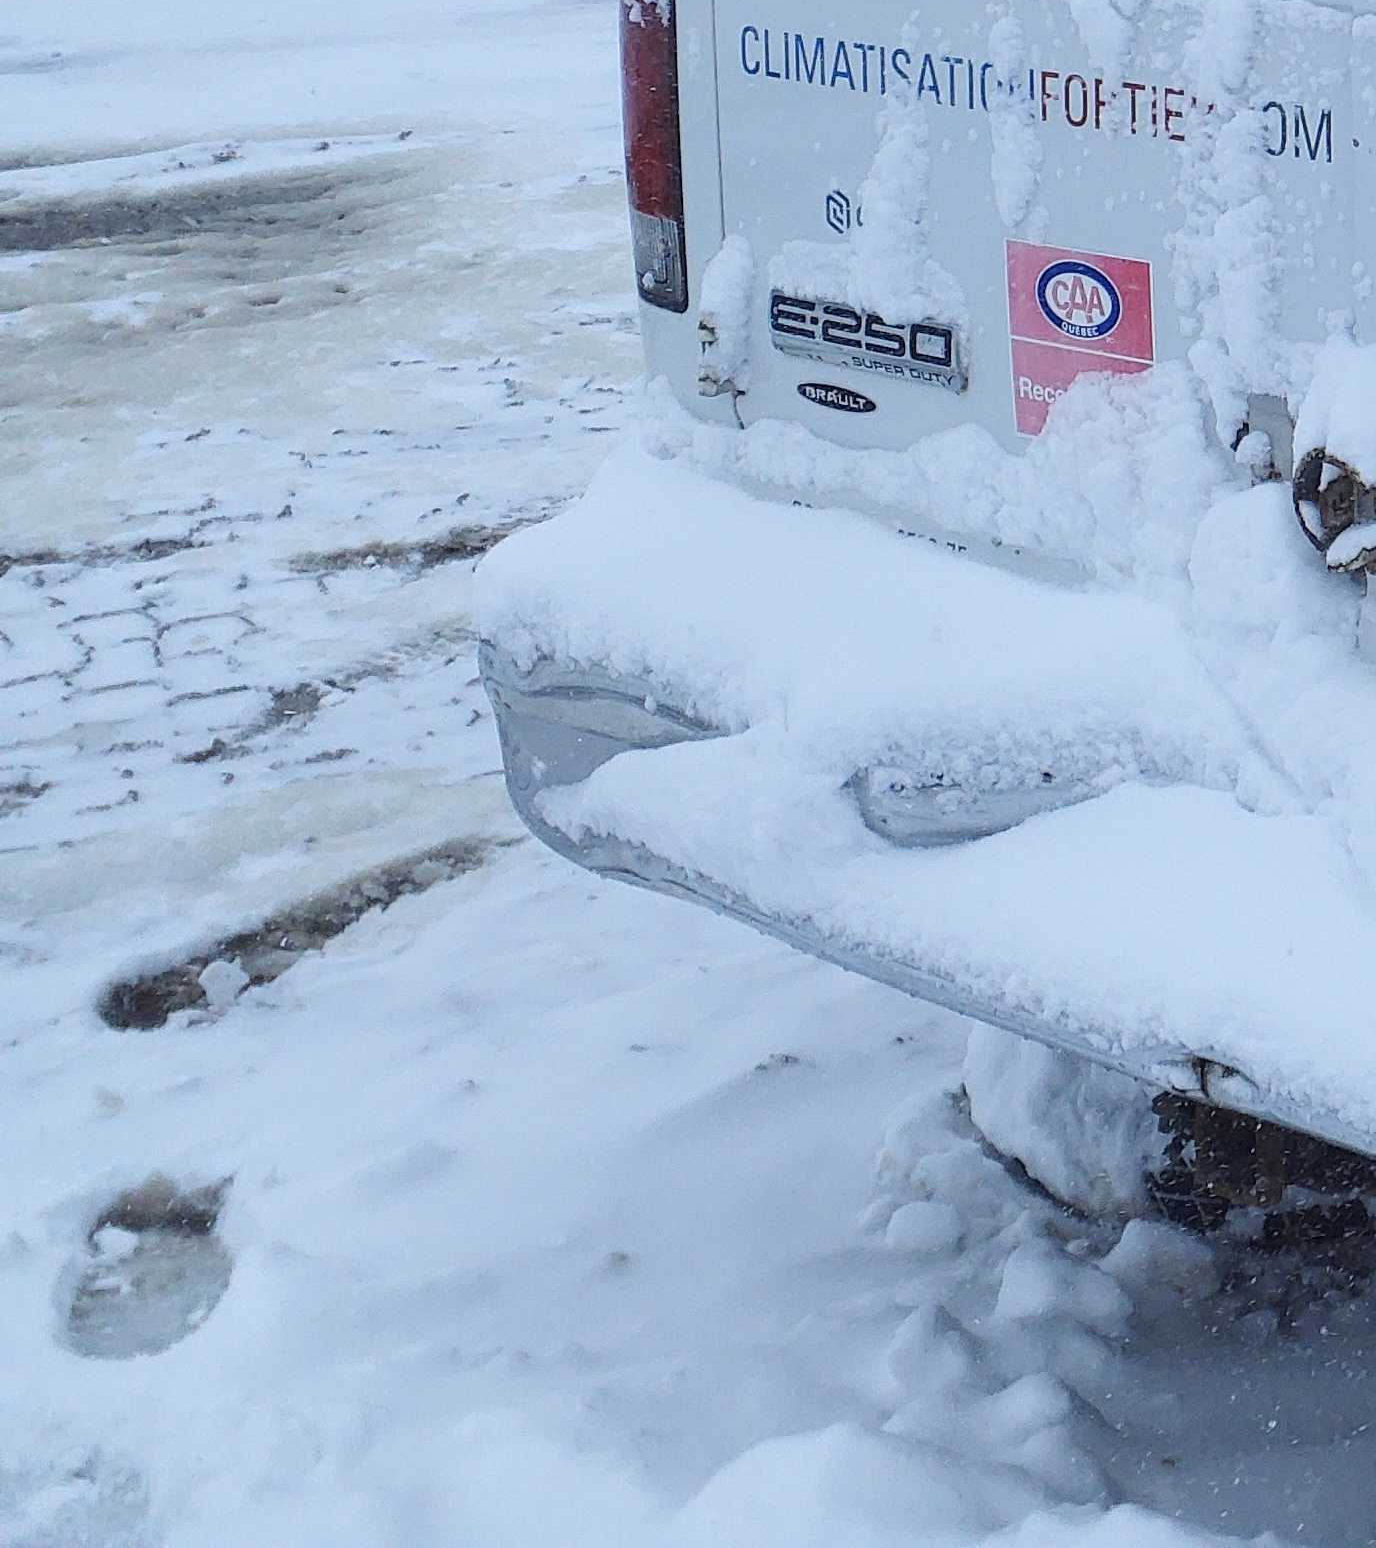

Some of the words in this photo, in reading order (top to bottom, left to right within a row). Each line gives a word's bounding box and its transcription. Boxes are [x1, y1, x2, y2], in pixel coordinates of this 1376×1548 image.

[1052, 275, 1105, 324] CAA
[851, 356, 905, 377] SUPER
[908, 368, 954, 388] DUTY
[805, 387, 867, 410] BRAULT
